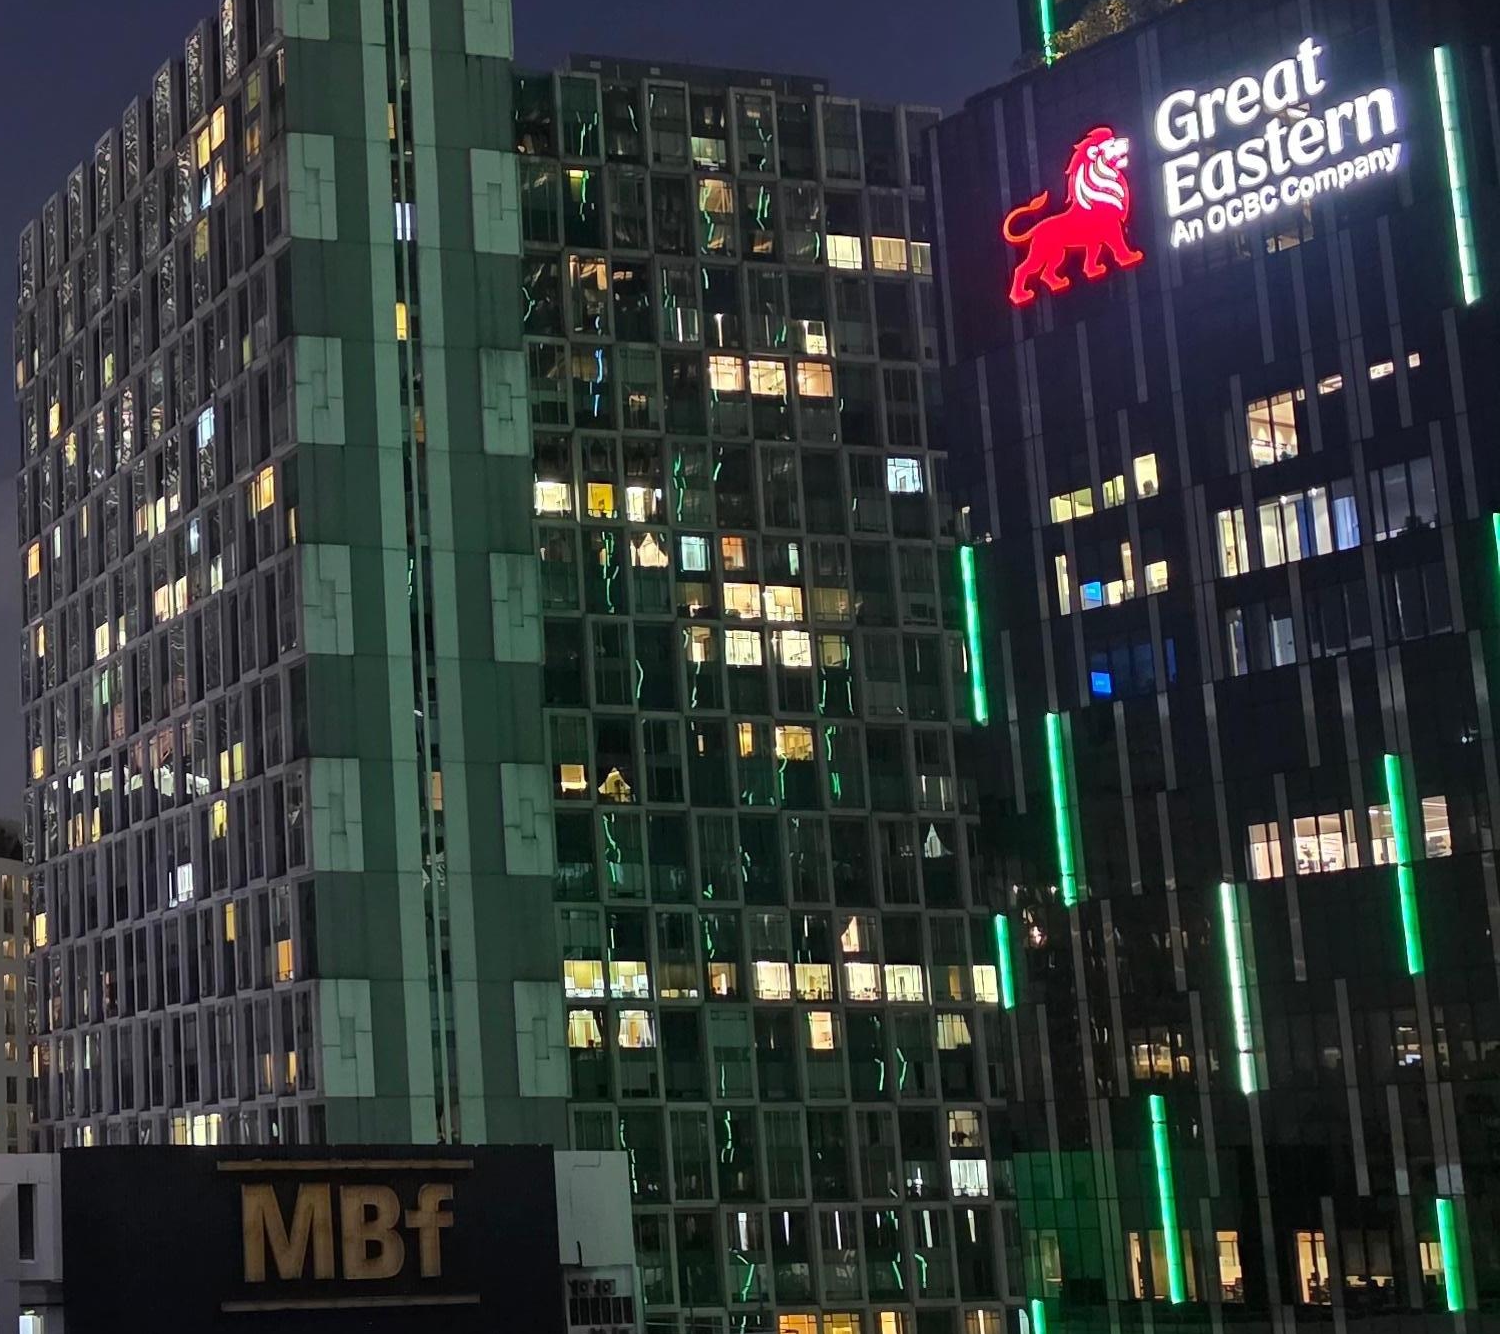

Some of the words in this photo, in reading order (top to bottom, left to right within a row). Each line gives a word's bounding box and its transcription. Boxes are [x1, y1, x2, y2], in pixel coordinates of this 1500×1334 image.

[1155, 37, 1327, 152] Great
[1162, 86, 1399, 218] Eastern
[1170, 218, 1205, 248] An
[1206, 186, 1280, 234] OCBC
[1280, 142, 1402, 206] Company
[240, 1182, 454, 1283] MBf
